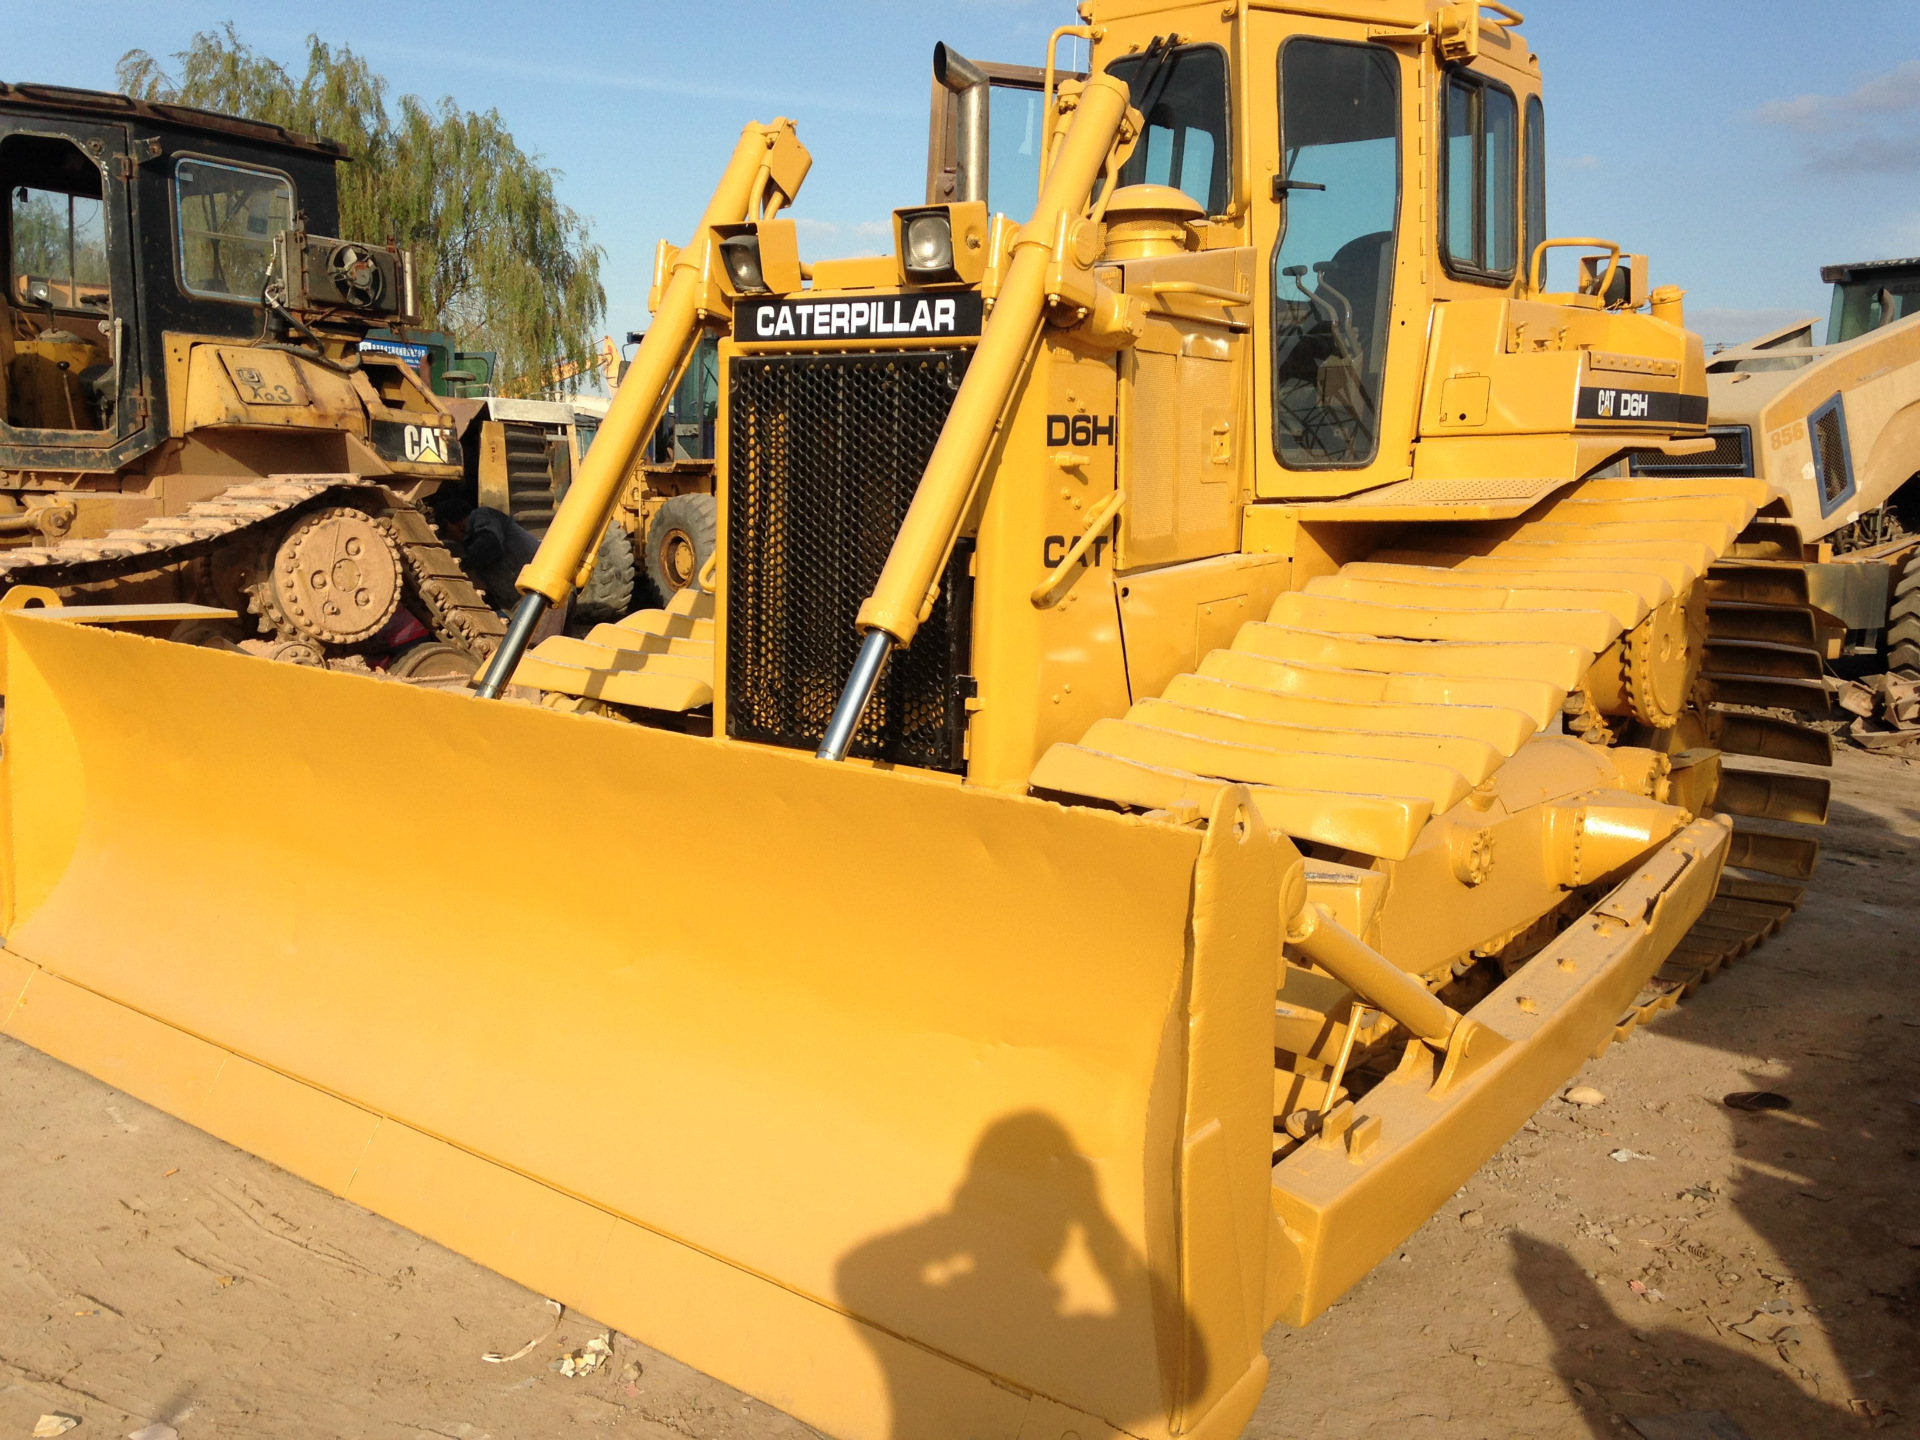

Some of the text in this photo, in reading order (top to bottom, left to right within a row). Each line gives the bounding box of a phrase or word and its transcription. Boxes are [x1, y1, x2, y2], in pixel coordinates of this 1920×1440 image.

[756, 299, 956, 336] CATERPILLAR
[1598, 389, 1649, 417] CAT D6H
[404, 425, 450, 463] CAT
[1047, 414, 1115, 446] D6H
[1770, 422, 1805, 451] 856
[1043, 535, 1108, 568] CAT
